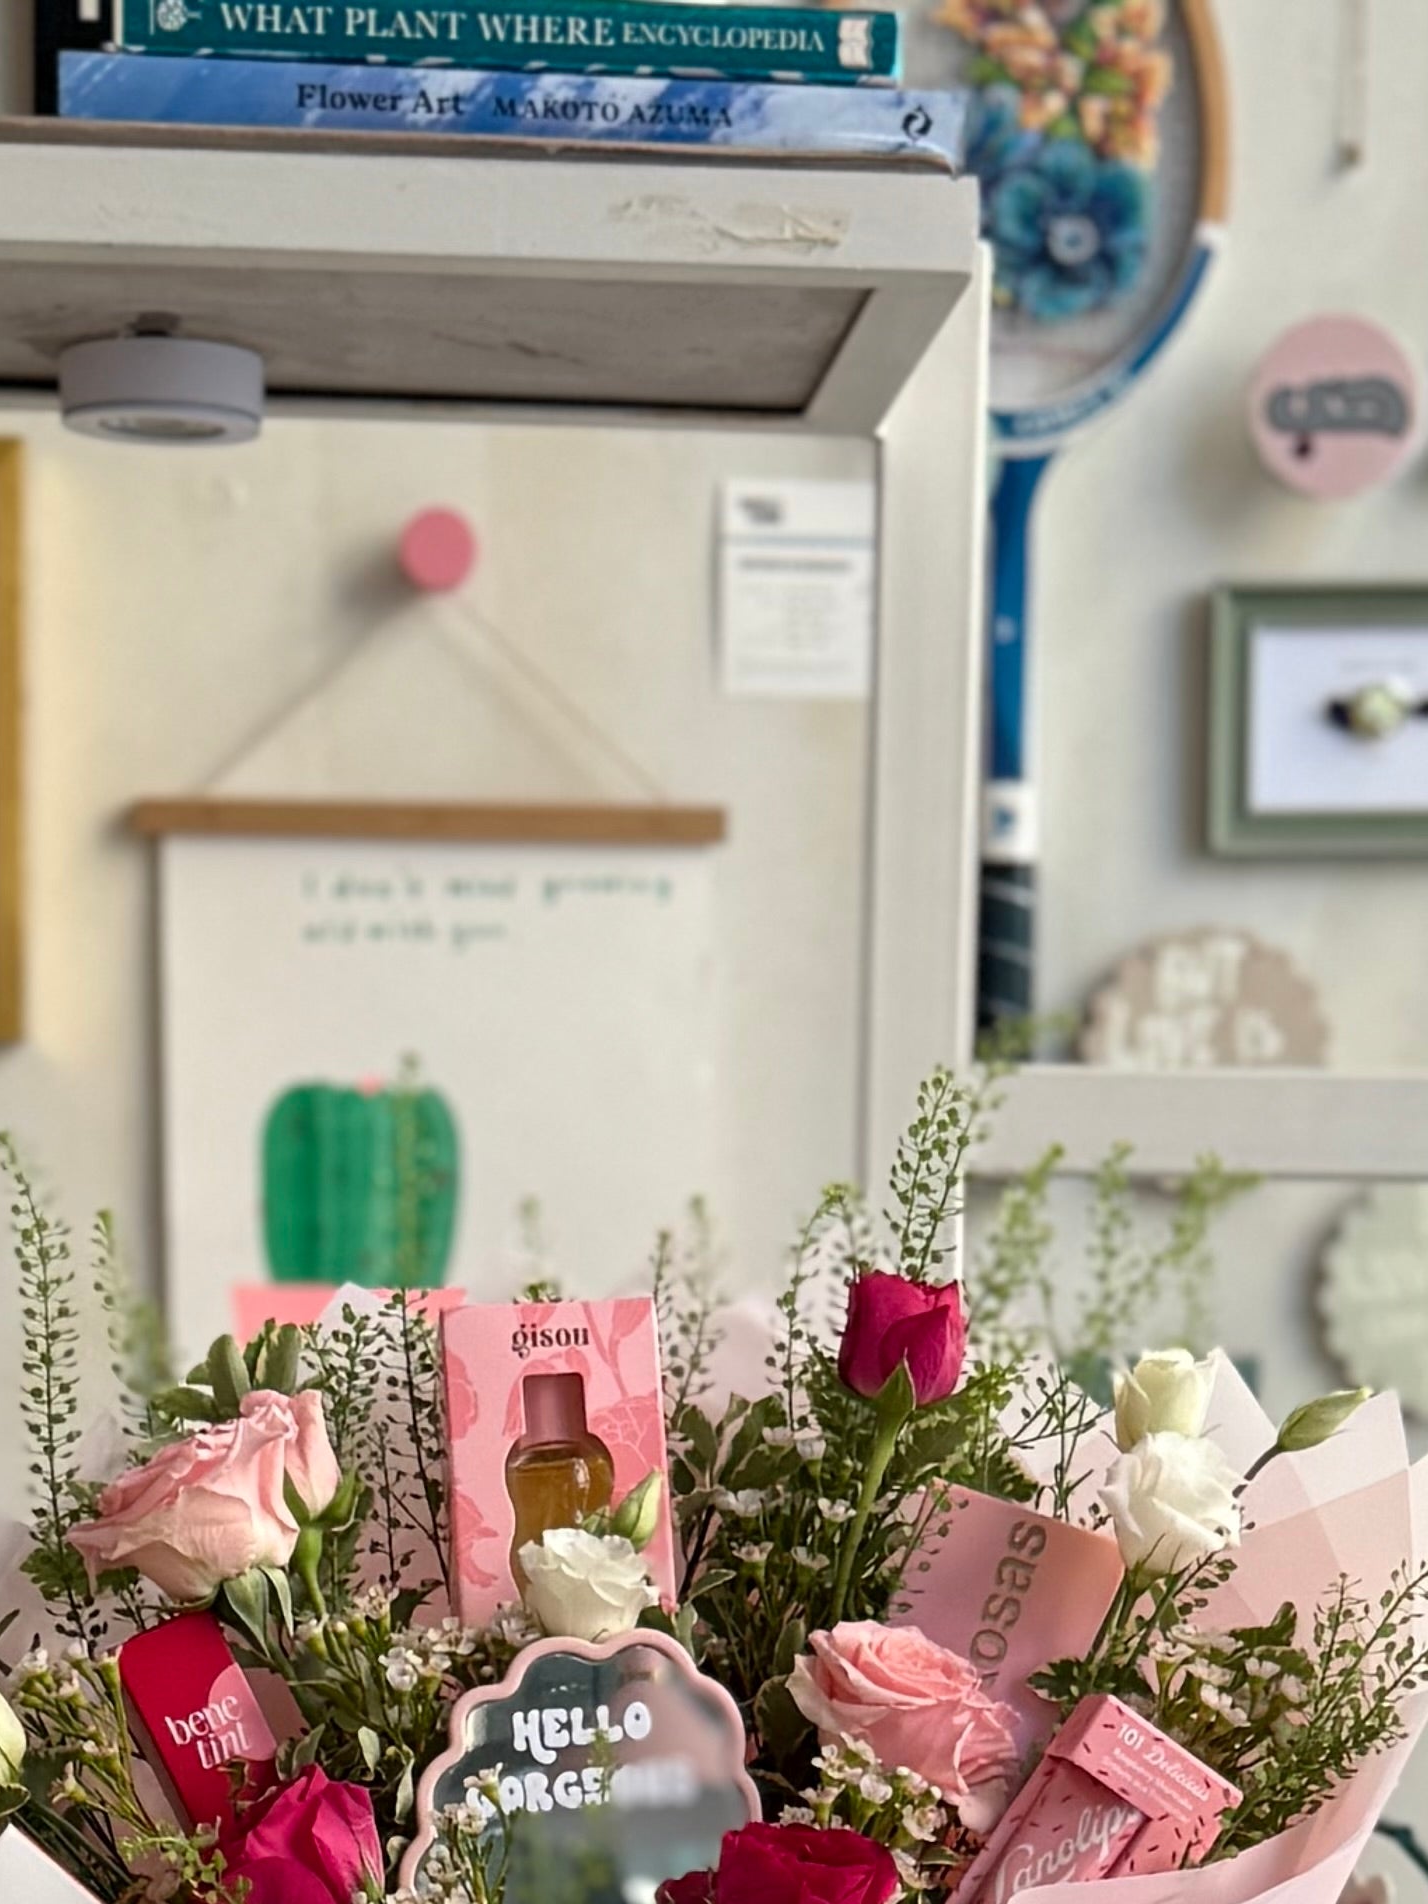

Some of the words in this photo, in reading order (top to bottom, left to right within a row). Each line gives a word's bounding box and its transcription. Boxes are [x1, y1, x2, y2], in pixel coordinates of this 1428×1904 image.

[220, 2, 332, 35] WHAT
[345, 6, 466, 40] PLANT
[477, 12, 614, 46] WHERE
[620, 24, 824, 53] ENCYCLOPEDIA
[297, 84, 403, 113] Flower
[413, 90, 466, 116] Art
[492, 97, 620, 123] MAKOTO
[626, 103, 734, 129] AZUMA
[511, 1323, 590, 1360] gisou
[512, 1701, 652, 1765] HELLO
[1117, 1723, 1145, 1751] 101
